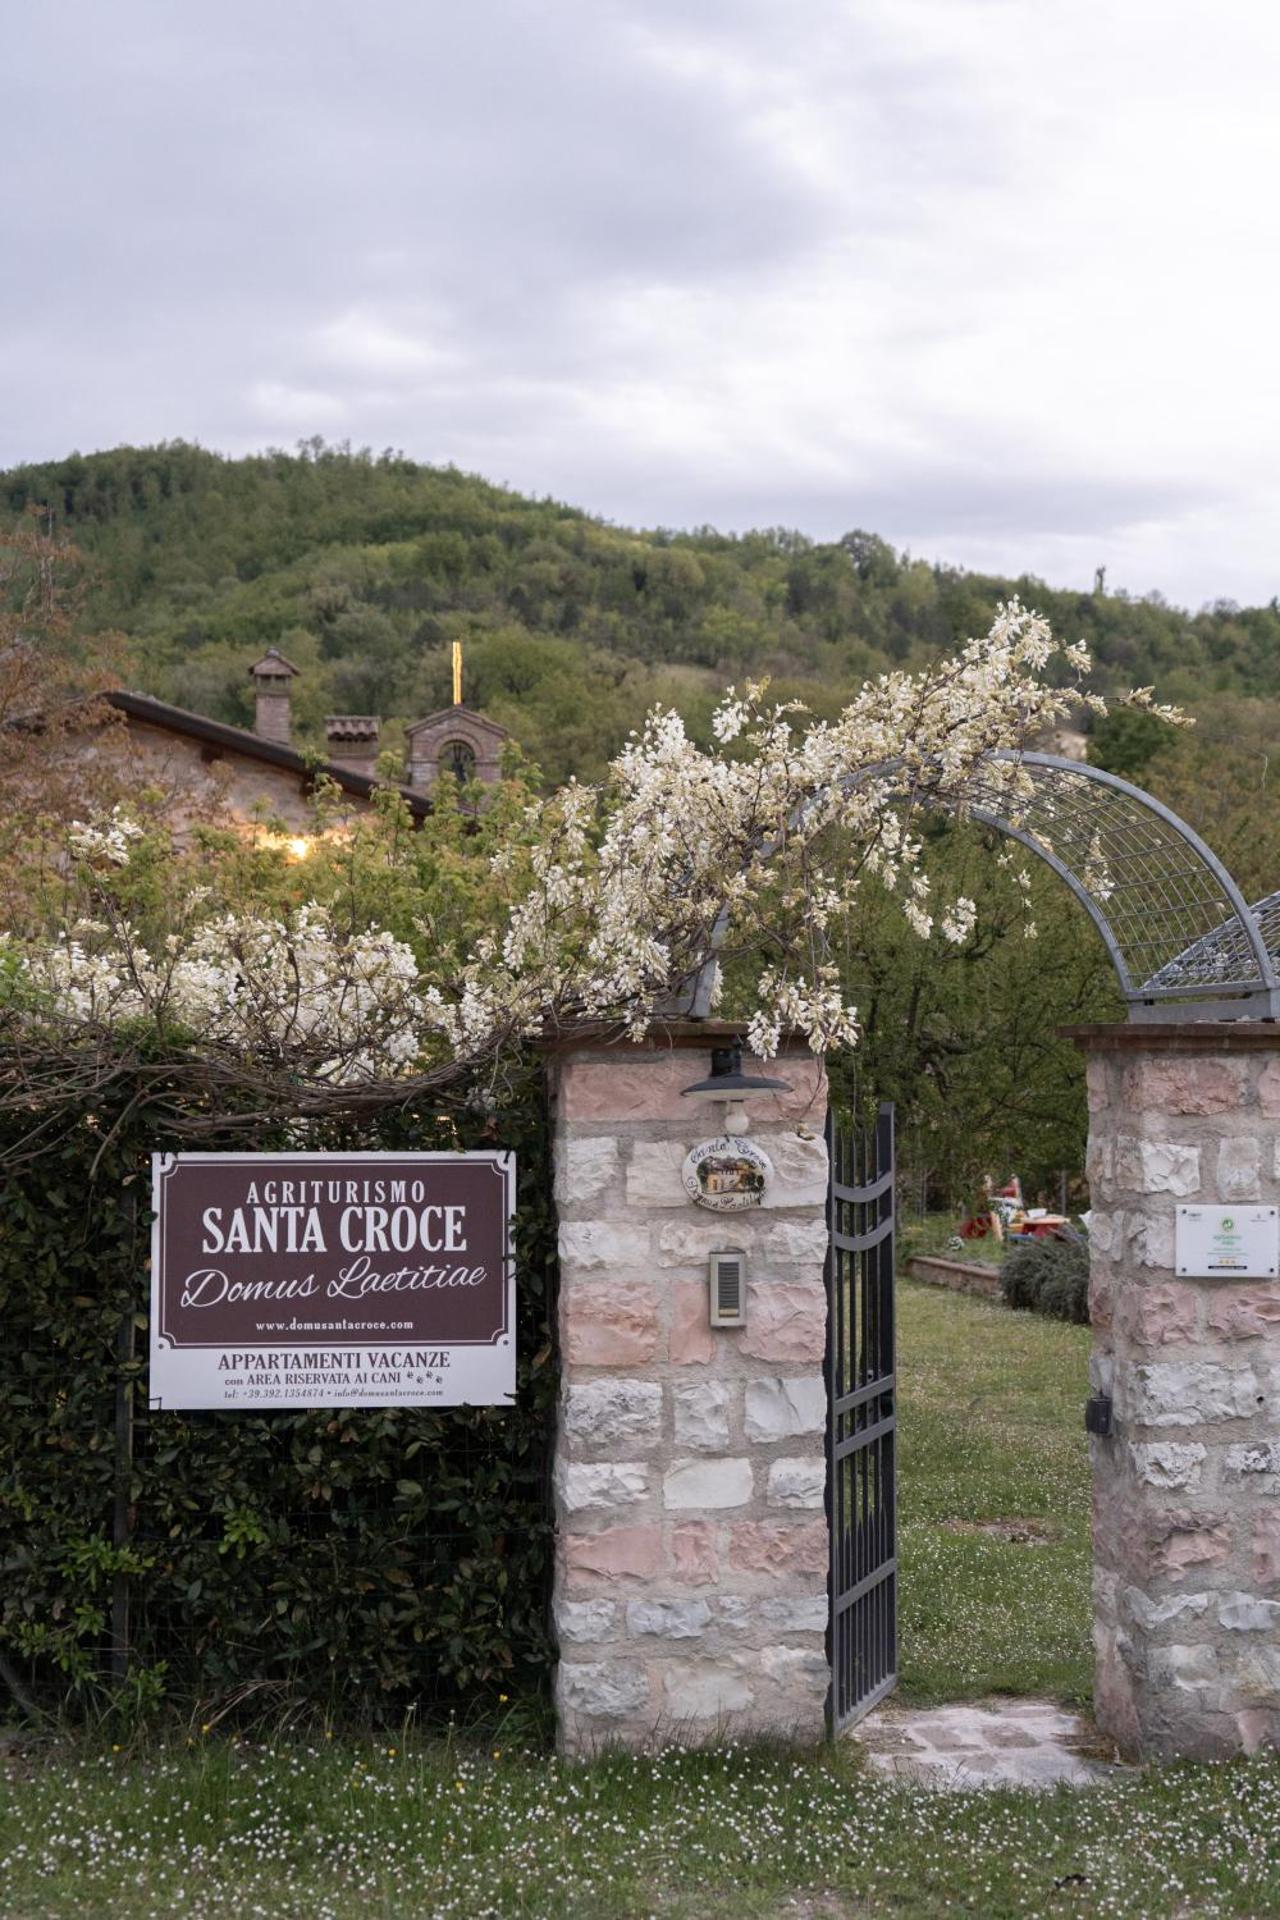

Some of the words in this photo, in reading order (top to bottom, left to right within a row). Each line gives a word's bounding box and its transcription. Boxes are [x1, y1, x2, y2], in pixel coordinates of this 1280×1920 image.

[246, 1180, 426, 1204] AGRITURISMO
[202, 1207, 327, 1253] SANTA
[339, 1206, 467, 1252] CROCE
[180, 1269, 319, 1308] Domus
[327, 1256, 488, 1299] Laetitiae
[255, 1316, 414, 1331] www.domusantacroce.com
[218, 1352, 361, 1370] APPARTAMENTI
[367, 1351, 450, 1368] VACANZE
[224, 1378, 243, 1386] con
[246, 1373, 281, 1385] AREA
[285, 1372, 350, 1385] RISERVATA
[354, 1372, 367, 1384] AI
[371, 1371, 401, 1384] CANI
